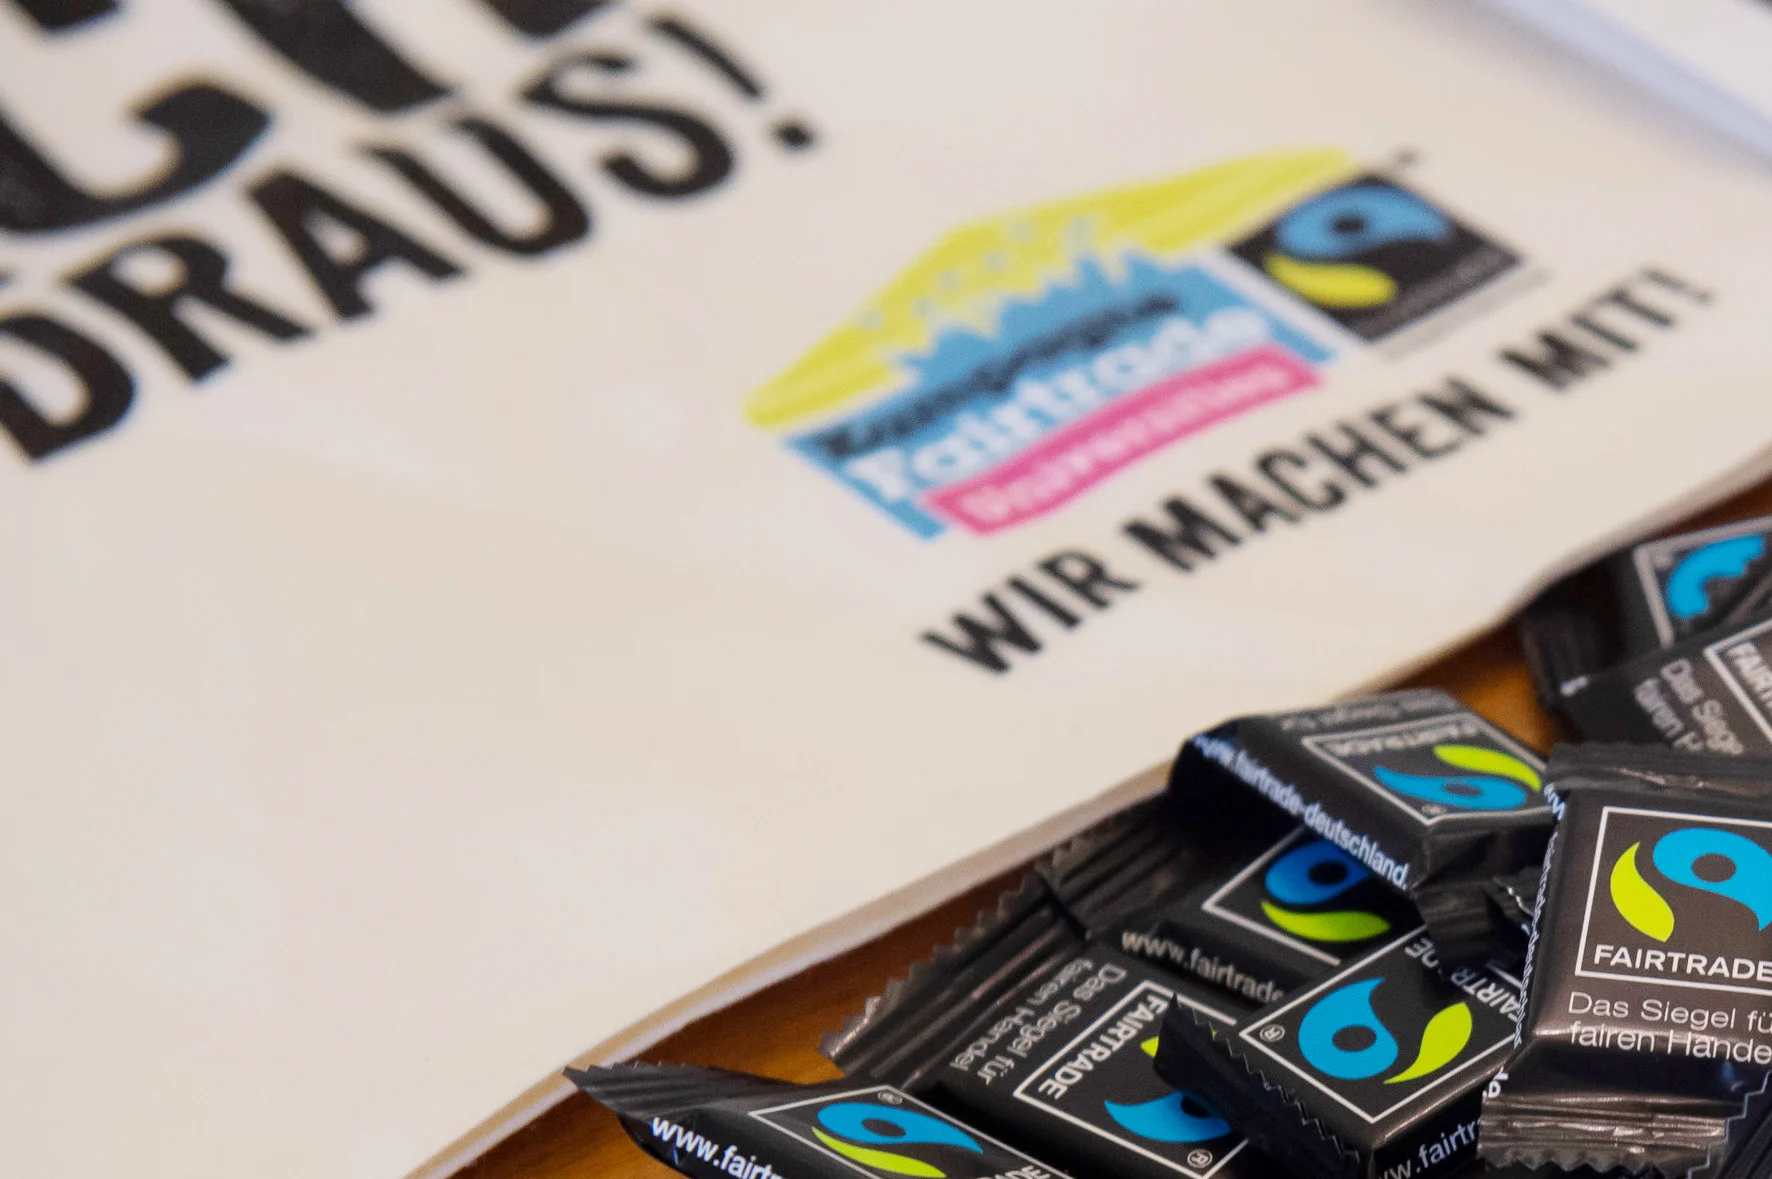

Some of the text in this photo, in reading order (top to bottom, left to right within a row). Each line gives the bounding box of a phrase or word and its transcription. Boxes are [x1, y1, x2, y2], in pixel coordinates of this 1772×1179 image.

[920, 547, 1142, 676] WIR
[1120, 374, 1522, 573] MACHEN
[1497, 267, 1720, 394] MIT!
[977, 963, 1127, 1085] Das Siegel für
[1038, 995, 1169, 1100] FAIRTRADE
[1568, 991, 1629, 1020] Das
[1641, 999, 1736, 1030] Siegel
[1569, 1020, 1655, 1052] fairen
